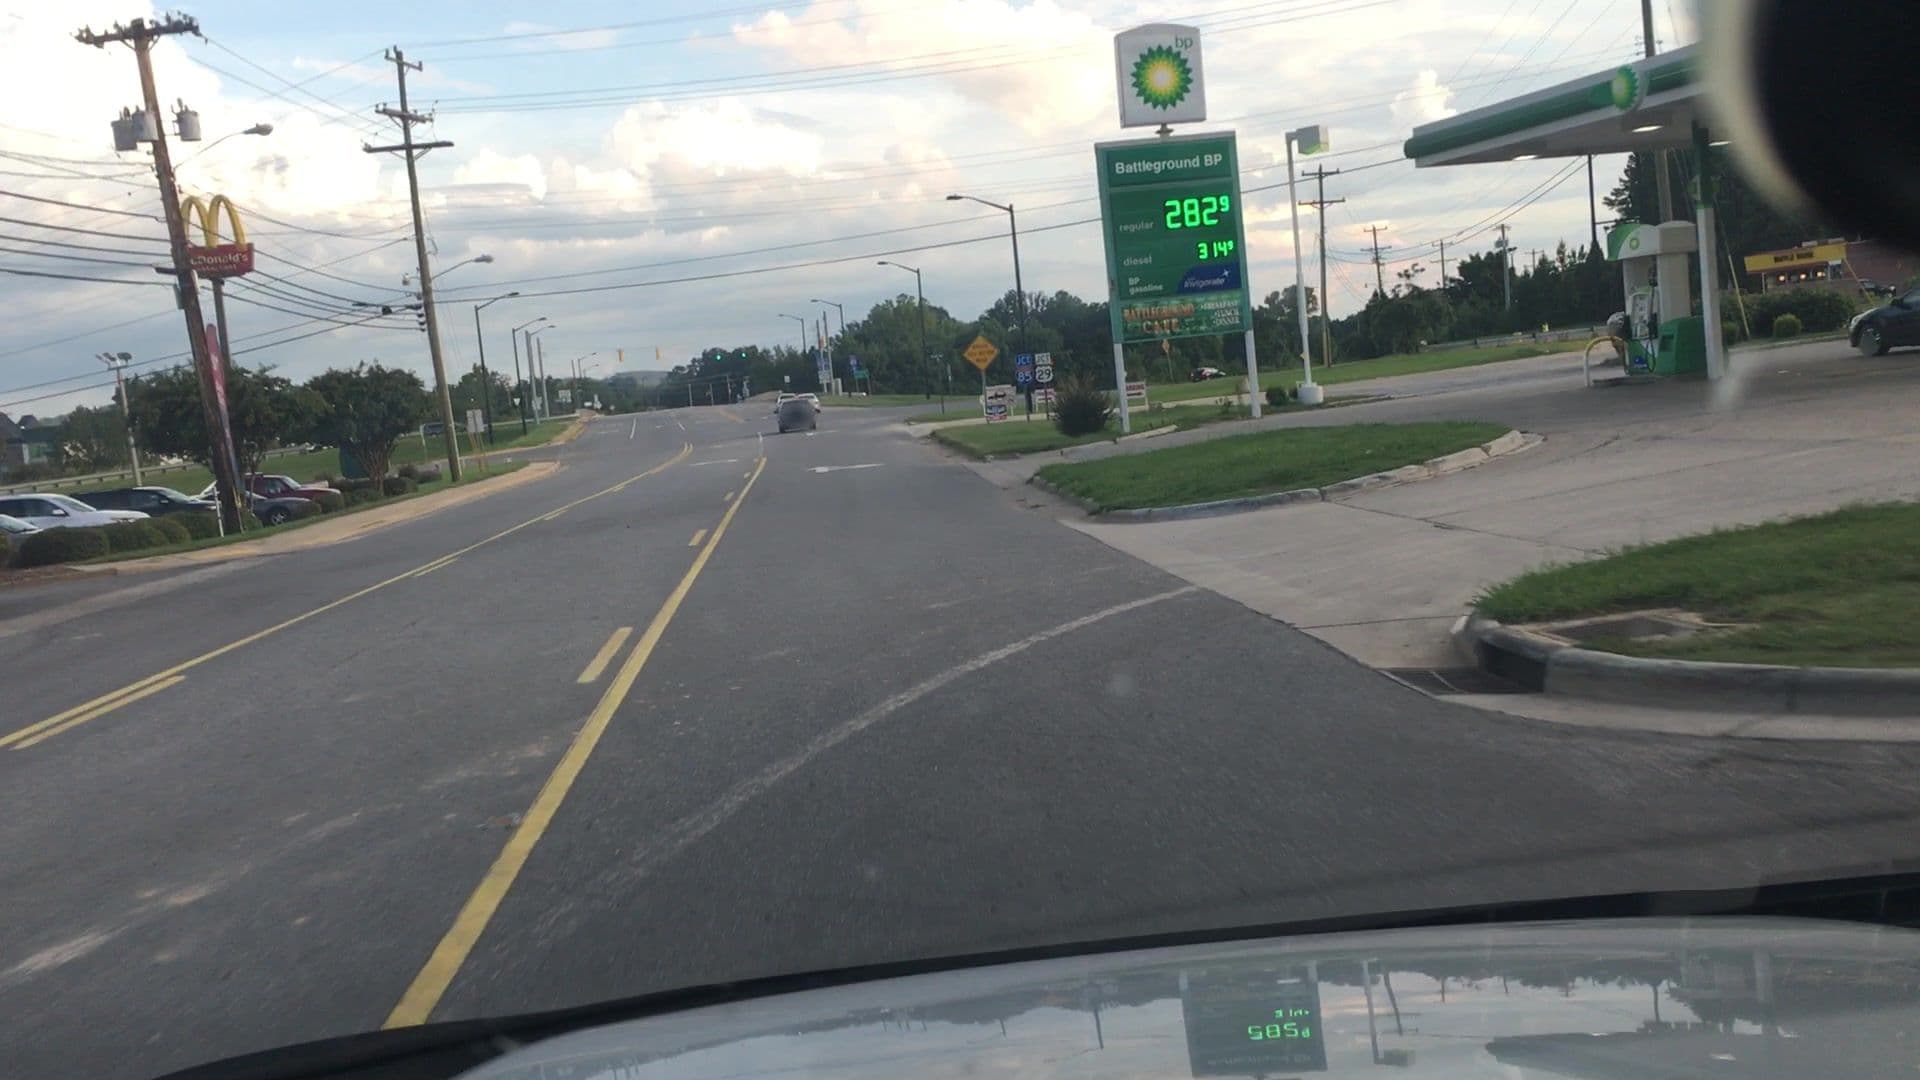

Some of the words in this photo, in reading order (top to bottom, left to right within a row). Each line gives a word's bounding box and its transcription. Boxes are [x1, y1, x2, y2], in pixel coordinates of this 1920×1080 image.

[1175, 35, 1193, 49] bp
[1115, 156, 1200, 174] Battleground
[1204, 153, 1222, 166] BP
[1119, 220, 1154, 233] regular
[1123, 256, 1152, 266] diesel
[1128, 277, 1140, 286] BP
[1129, 284, 1163, 295] gasoline
[1018, 372, 1033, 382] 85
[1037, 368, 1052, 381] 29
